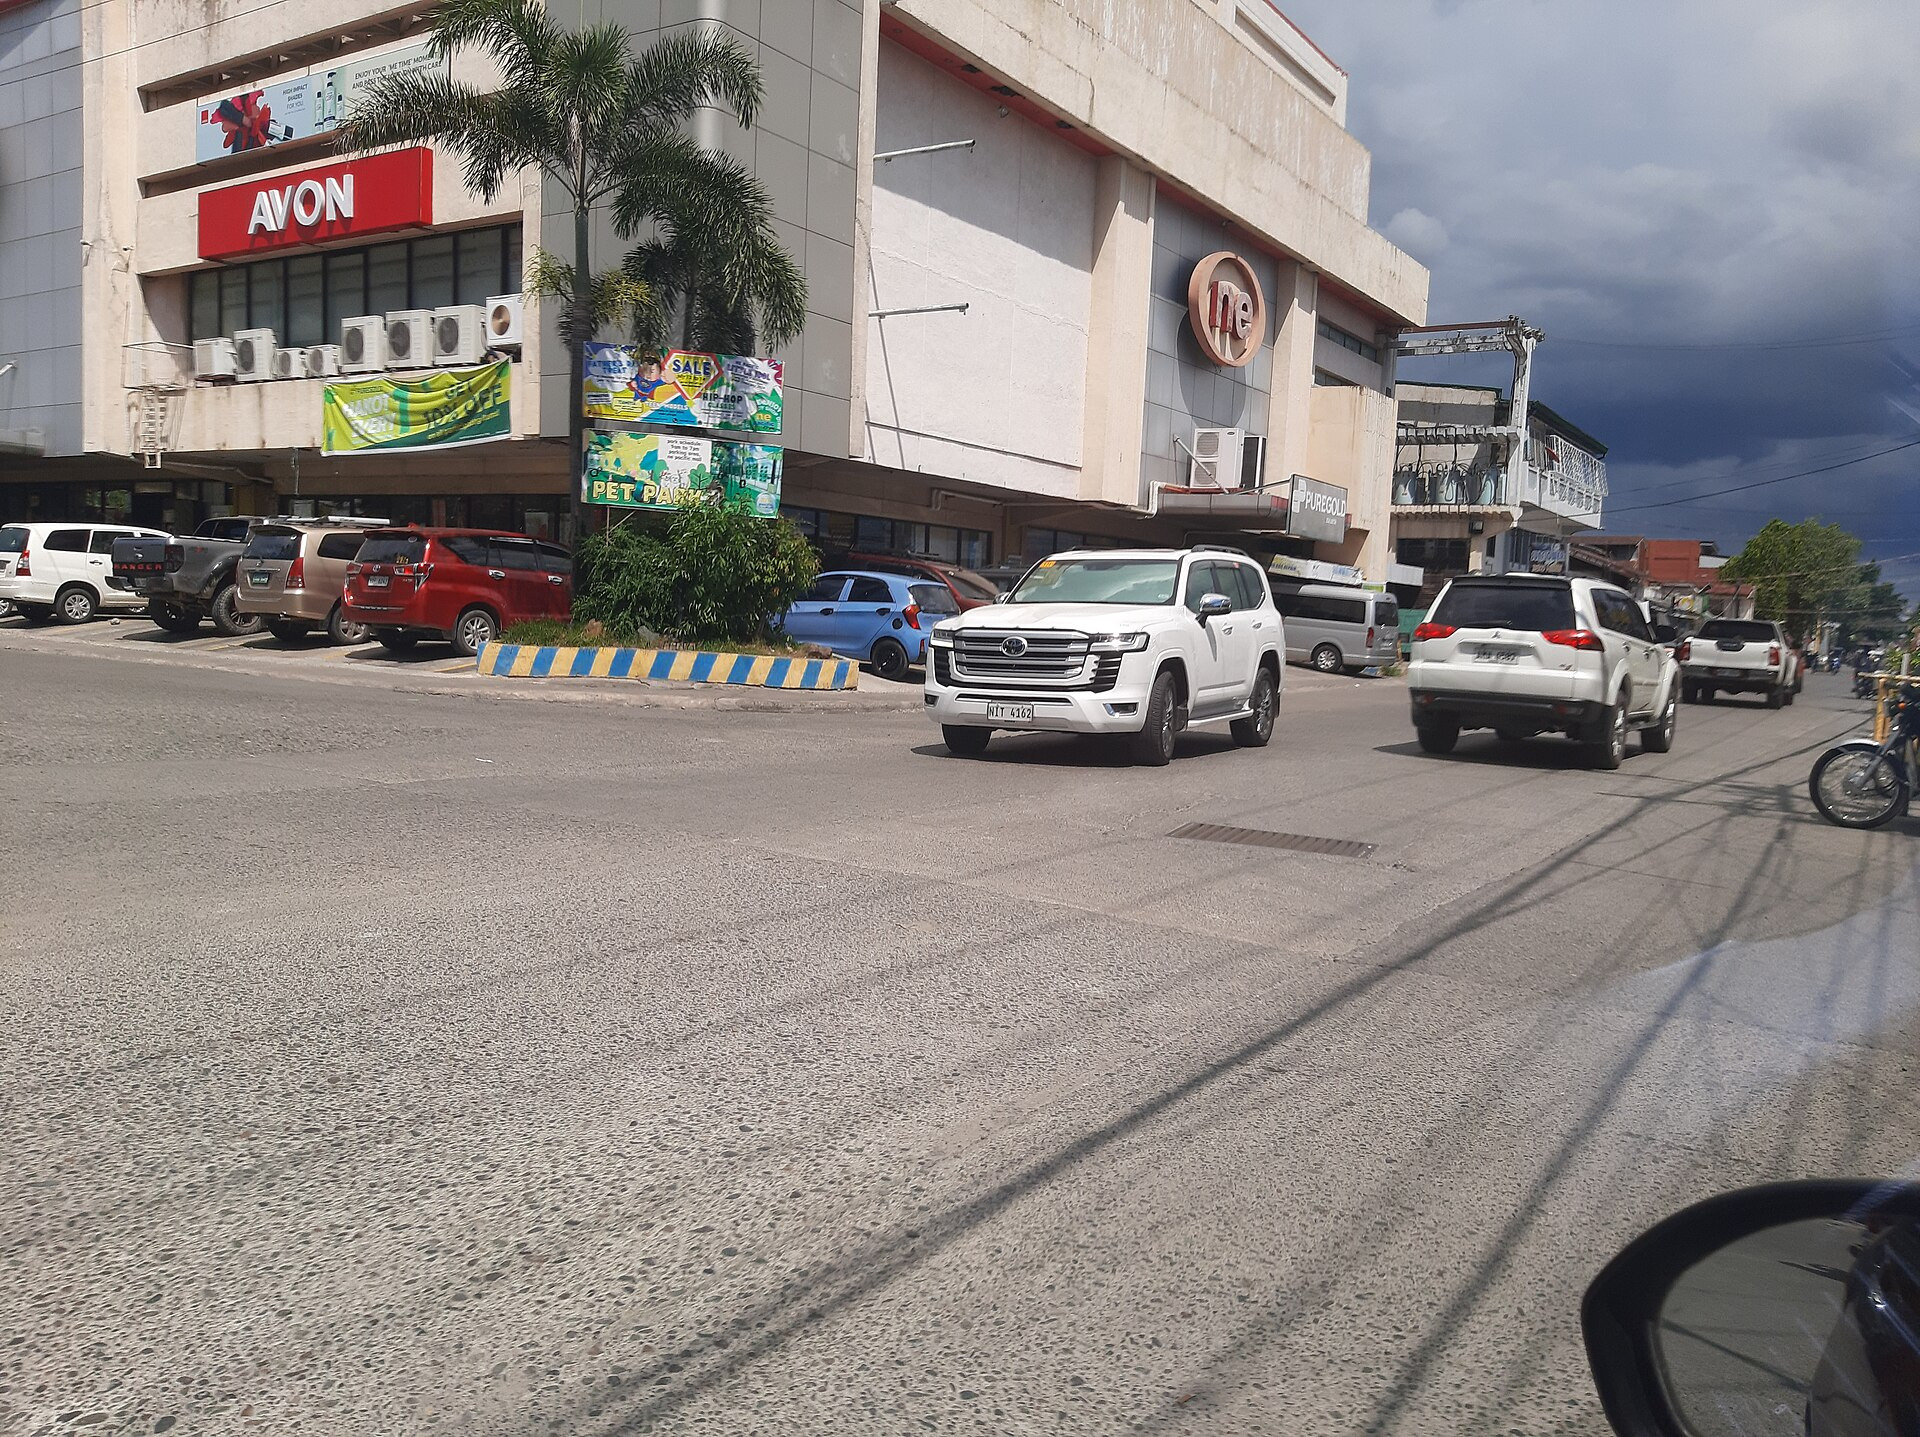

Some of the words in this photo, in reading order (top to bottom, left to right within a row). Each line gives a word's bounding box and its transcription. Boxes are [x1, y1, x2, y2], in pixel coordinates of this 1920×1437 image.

[428, 61, 441, 70] CARE
[355, 68, 371, 79] ENJOY
[372, 66, 386, 75] YOUR
[293, 84, 308, 93] IMPACT
[352, 80, 364, 89] AND
[248, 174, 354, 235] AVON
[673, 360, 711, 376] SALE
[464, 383, 502, 414] OFF
[702, 392, 743, 404] HIP-HOP
[592, 481, 635, 502] PET
[1305, 491, 1346, 518] PUREGOLD
[990, 706, 1004, 717] NIT
[1010, 708, 1032, 718] 4162
